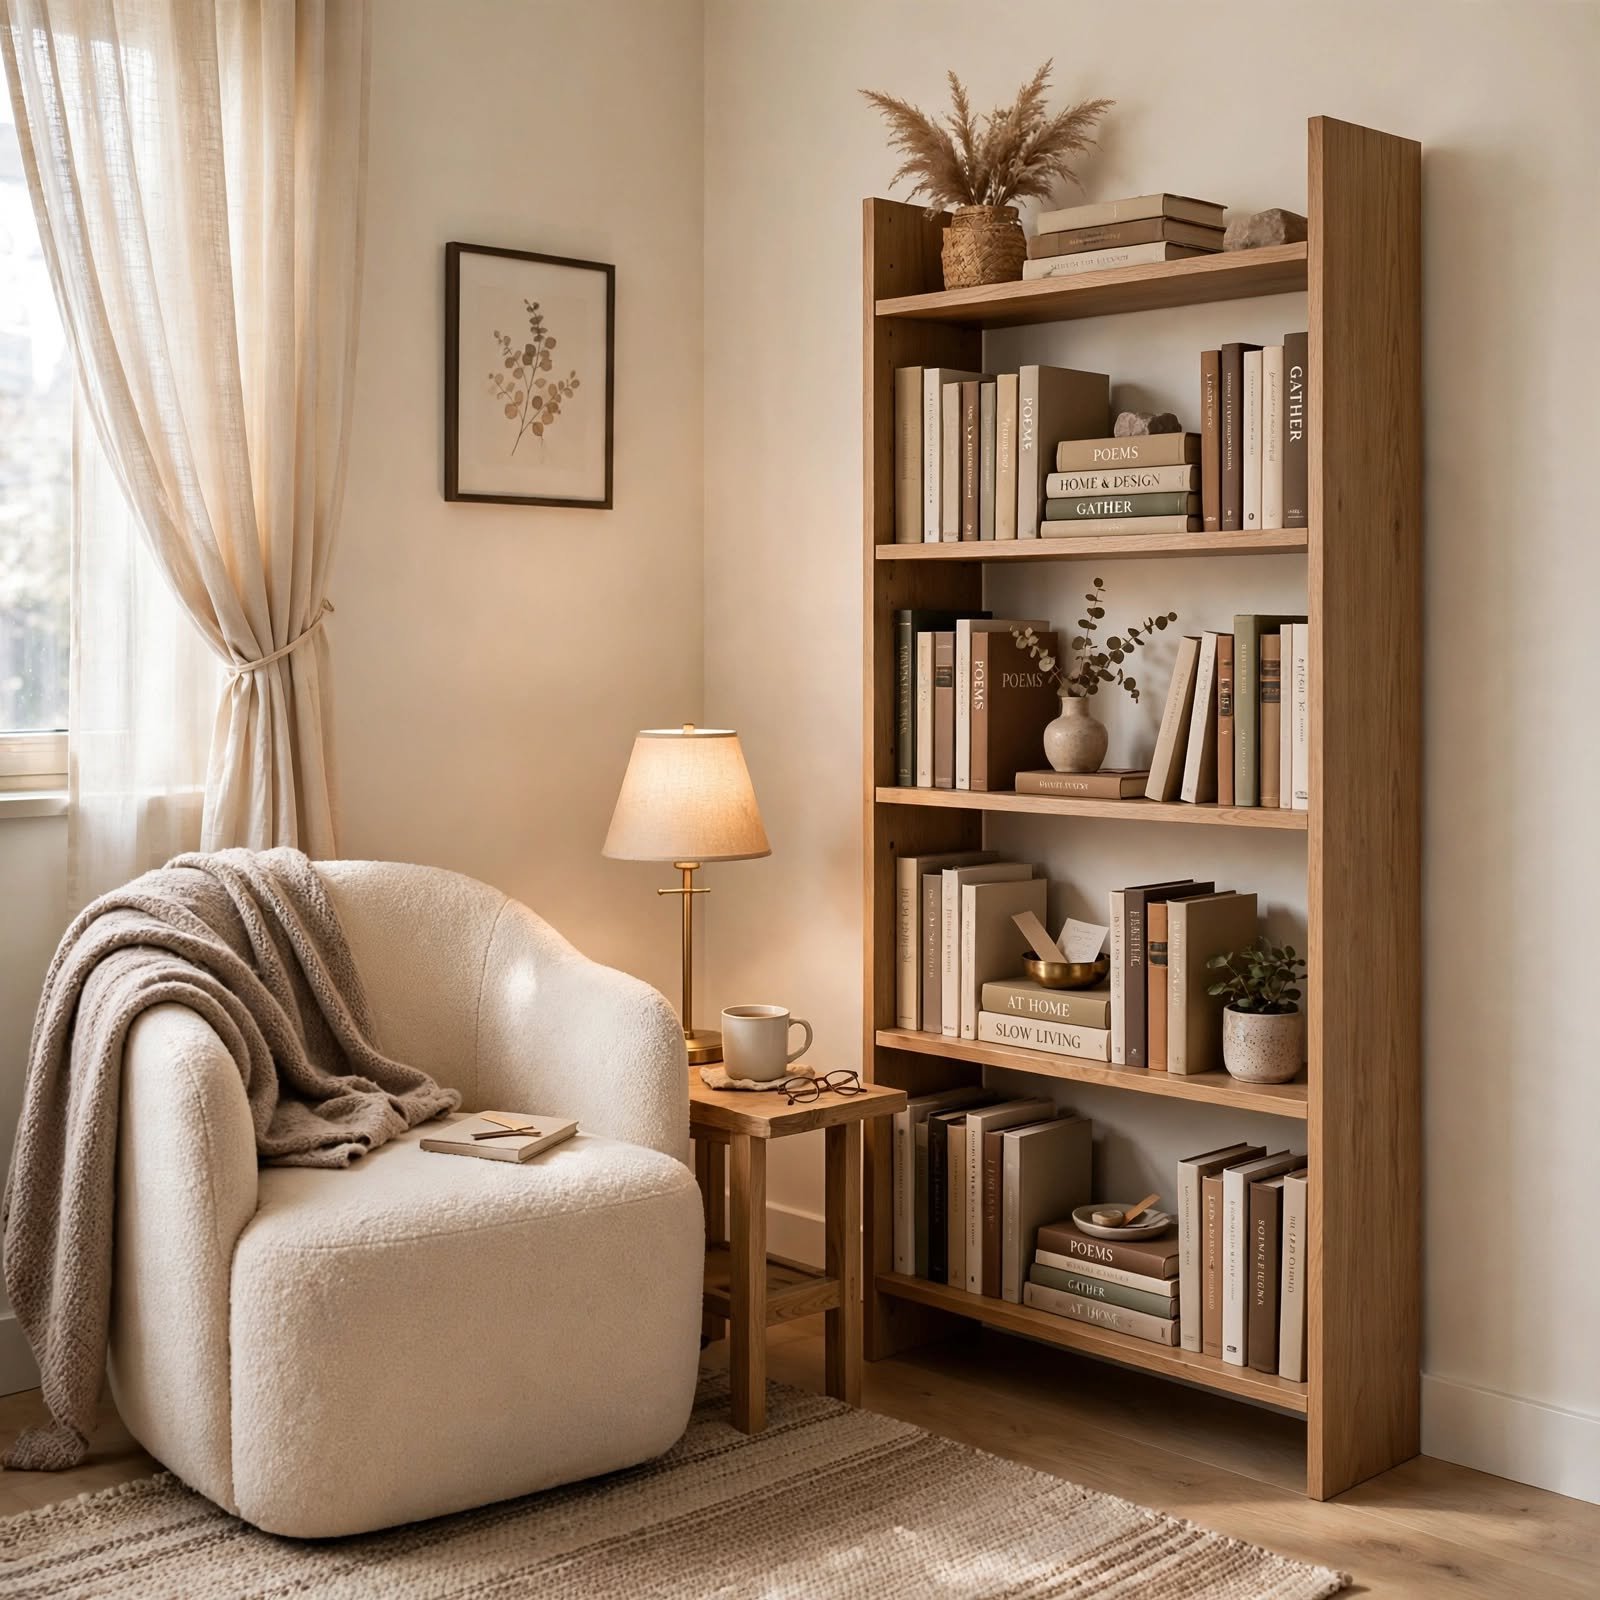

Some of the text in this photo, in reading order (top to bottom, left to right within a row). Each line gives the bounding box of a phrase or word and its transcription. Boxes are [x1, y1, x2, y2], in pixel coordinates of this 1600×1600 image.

[1289, 365, 1303, 443] GATHER
[1093, 446, 1139, 462] POEMS
[1060, 473, 1161, 491] HOME & DESIGN
[1076, 501, 1132, 515] GATHER
[974, 660, 984, 710] POEMS
[1002, 672, 1043, 688] POEMS
[1007, 996, 1070, 1018] AT HOME
[995, 1023, 1081, 1049] SLOW LIVING
[1070, 1239, 1113, 1262] POEMS
[1067, 1279, 1105, 1298] GATHER
